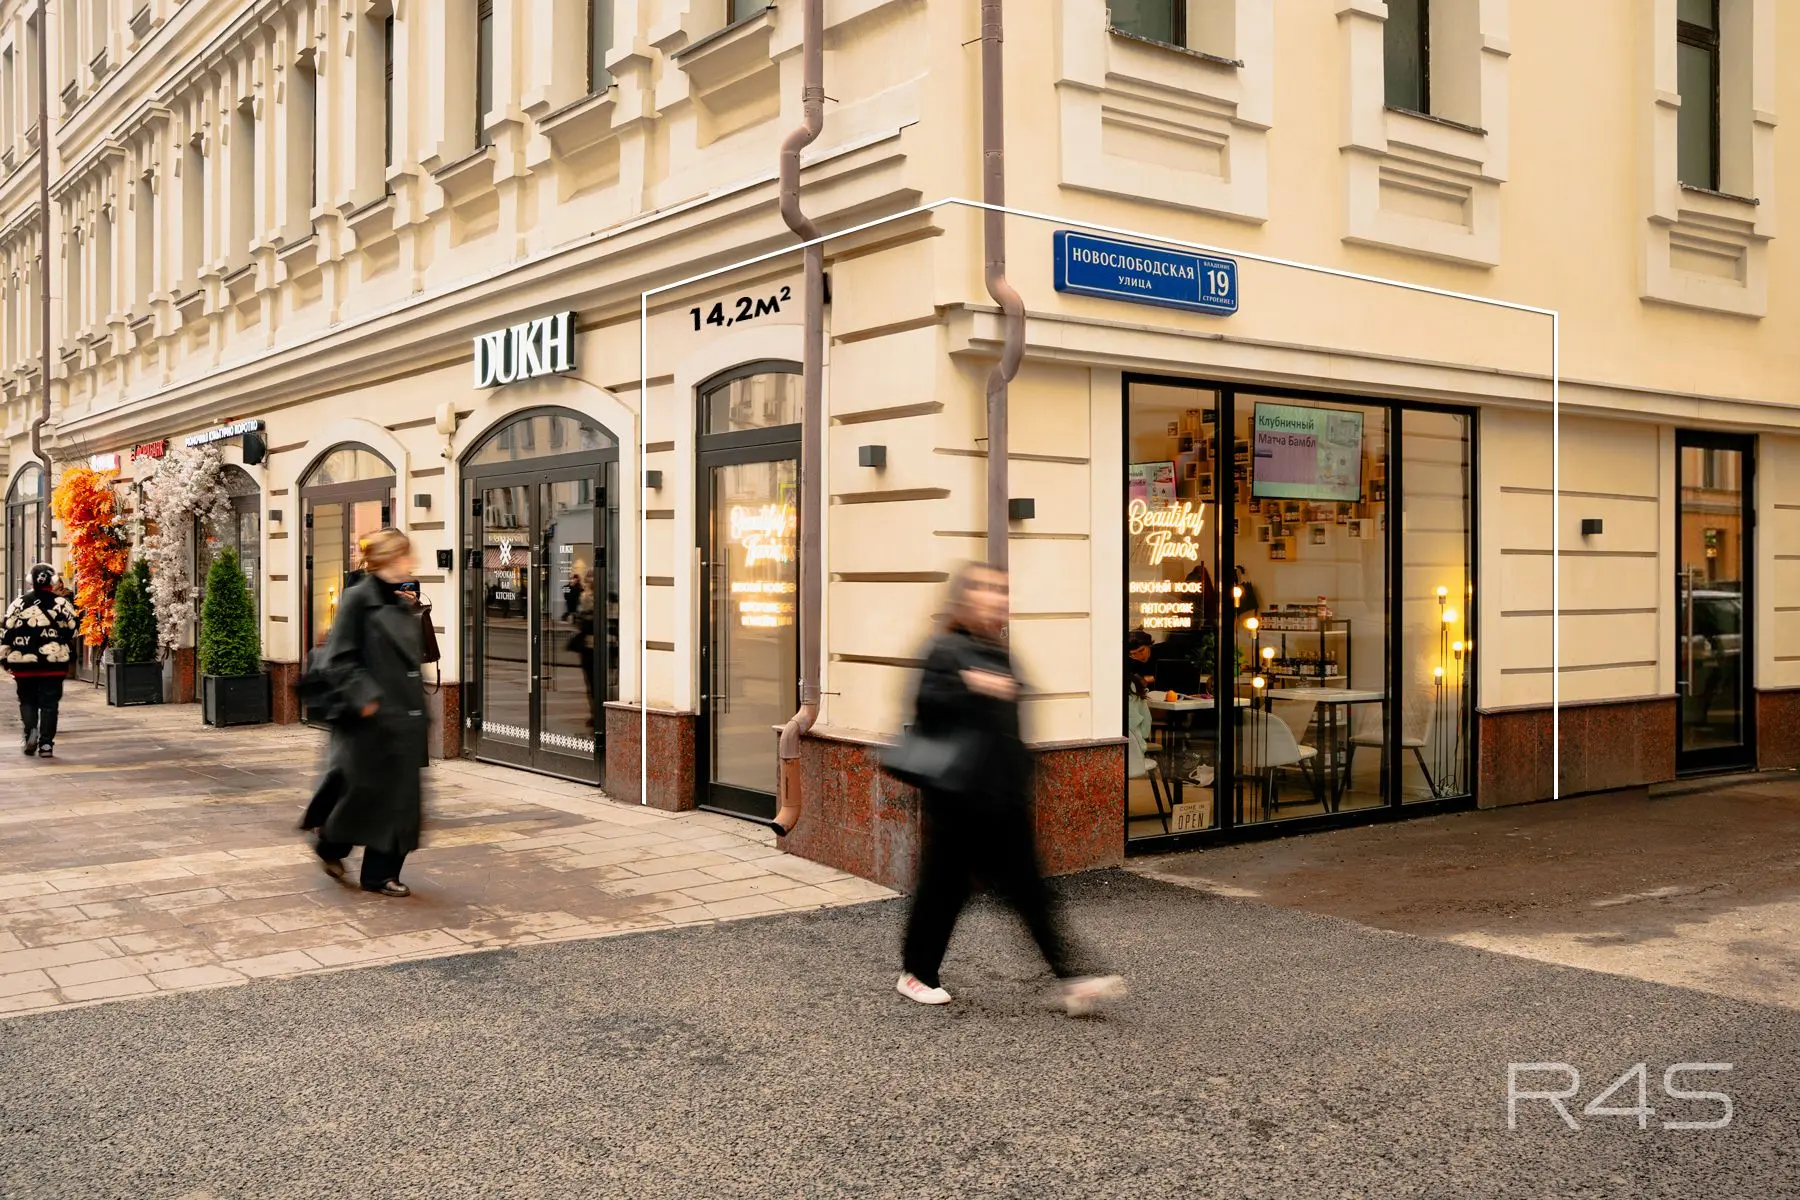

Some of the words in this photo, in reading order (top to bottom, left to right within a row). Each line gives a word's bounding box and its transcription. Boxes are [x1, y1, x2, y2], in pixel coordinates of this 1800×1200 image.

[1072, 247, 1194, 280] НОВОСЛОБОДСКАЯ
[1203, 261, 1230, 271] ВЛАДЕНИЕ
[1118, 275, 1152, 289] УЛИЦА
[1207, 270, 1229, 297] 19
[1202, 295, 1230, 305] СТРОЕНИЕ
[473, 311, 577, 390] DUKH
[1258, 415, 1314, 430] Клубничный
[1258, 433, 1286, 446] Матча
[1288, 435, 1316, 448] Бамбл
[1129, 499, 1205, 536] Beautiful
[1174, 582, 1202, 593] КОФЕ
[495, 591, 516, 600] KITCHEN
[1179, 813, 1204, 829] OPEN
